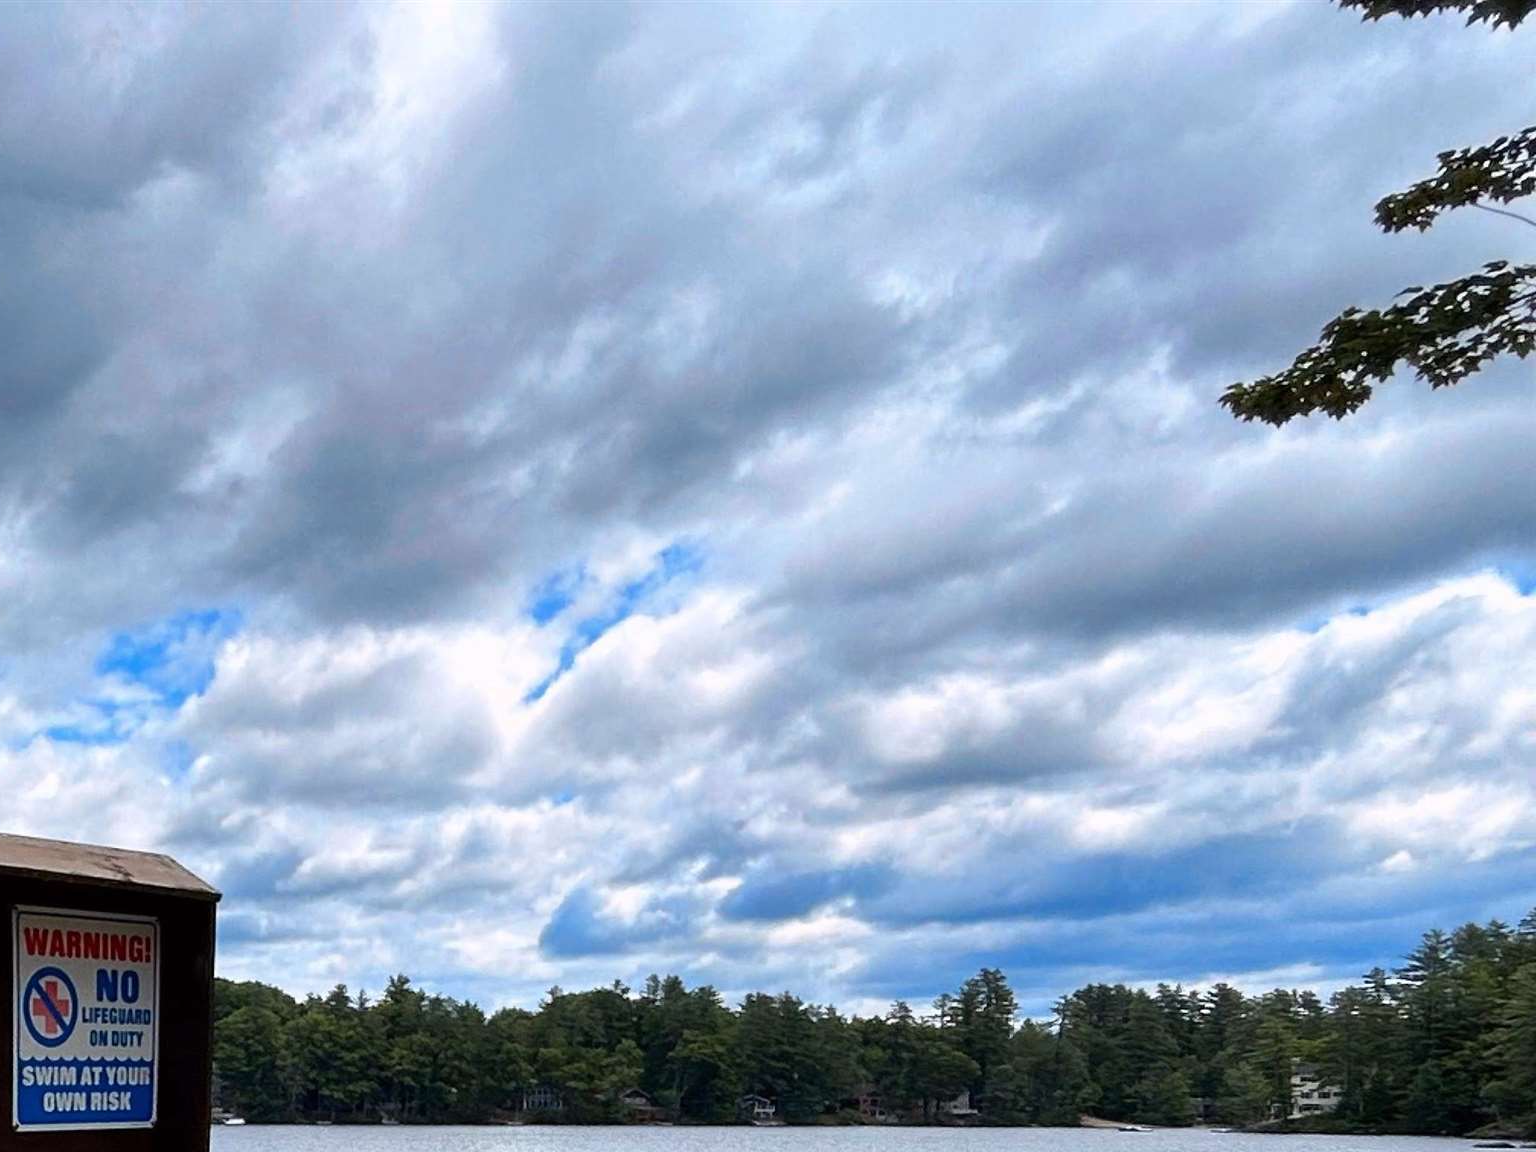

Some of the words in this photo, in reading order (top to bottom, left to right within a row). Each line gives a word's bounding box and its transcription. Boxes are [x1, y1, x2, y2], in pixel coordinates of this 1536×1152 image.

[24, 927, 152, 963] WARNING!
[96, 968, 140, 1003] NO
[81, 1007, 152, 1026] LIFEGUARD
[89, 1030, 108, 1047] ON
[111, 1031, 144, 1047] DUTY
[22, 1065, 77, 1086] SWIM
[79, 1066, 103, 1086] AT
[106, 1065, 151, 1086] YOUR
[43, 1092, 87, 1112] OWN
[90, 1091, 132, 1111] RISK
